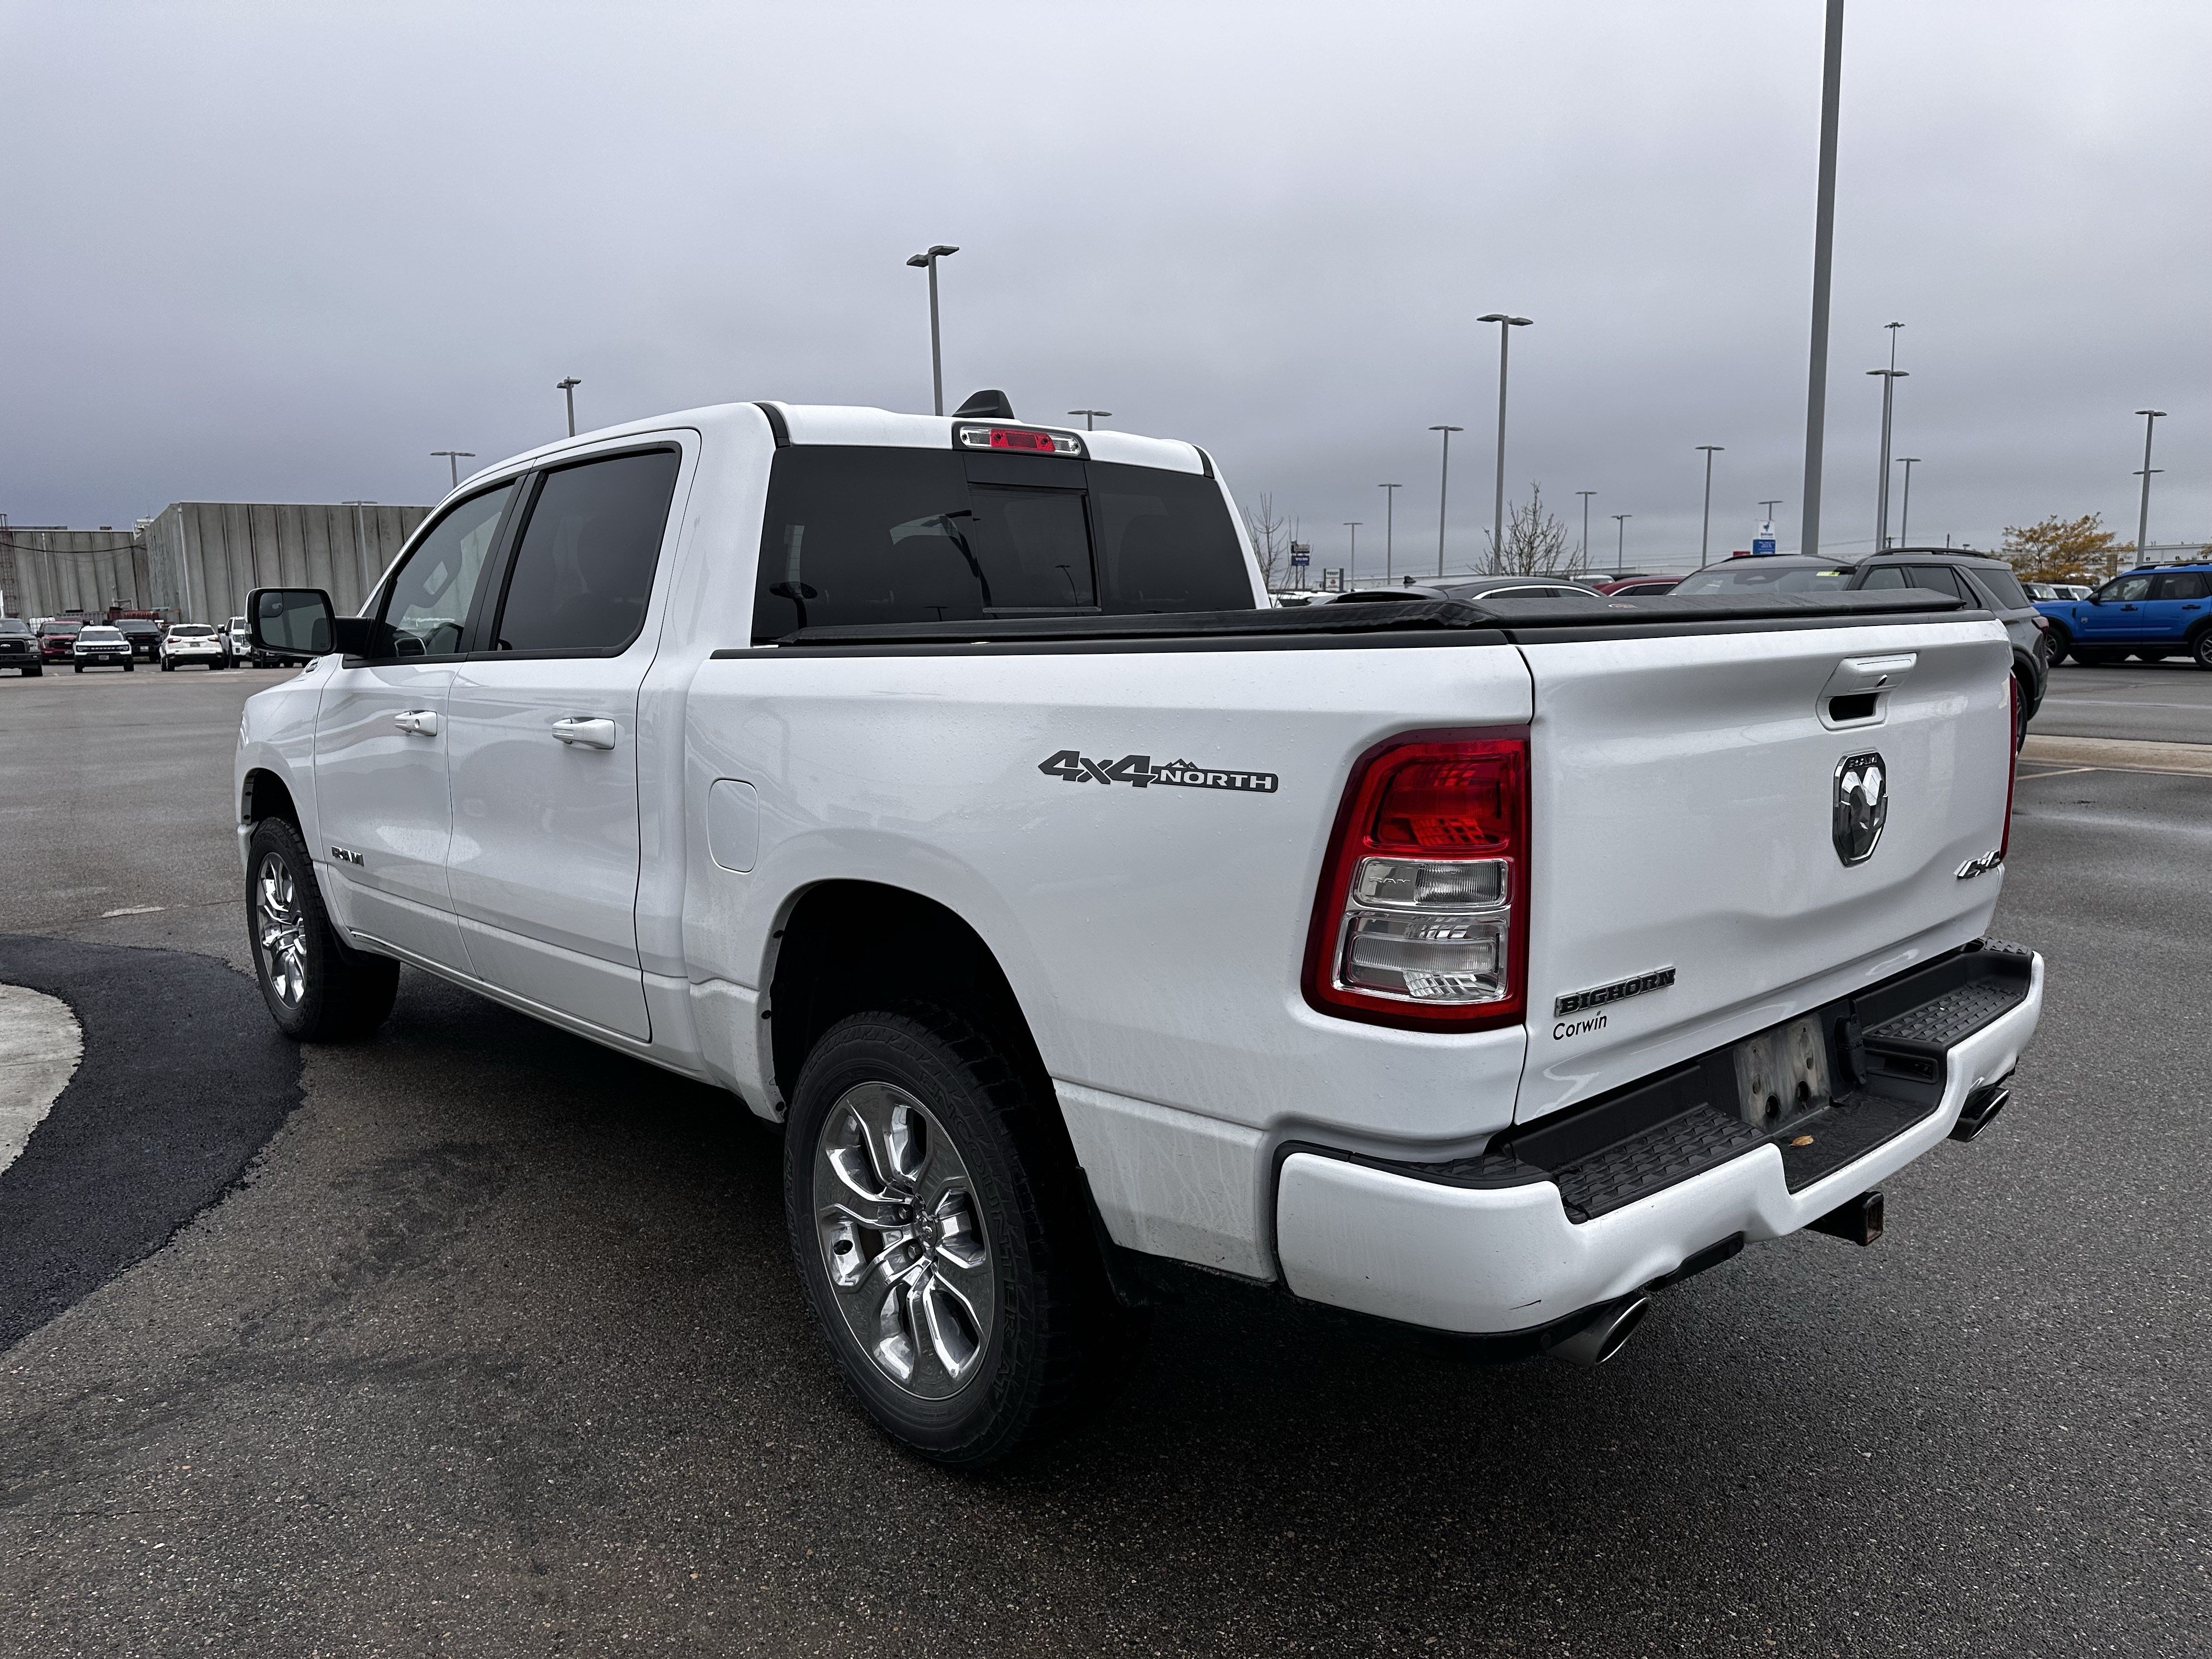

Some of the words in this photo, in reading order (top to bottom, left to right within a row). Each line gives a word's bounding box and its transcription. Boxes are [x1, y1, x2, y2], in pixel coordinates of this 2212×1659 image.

[1849, 754, 1877, 768] RAM
[1159, 769, 1272, 790] NORTH
[331, 845, 364, 867] RAM
[1554, 967, 1676, 1017] BIGHORN
[1553, 1011, 1607, 1041] Corwin
